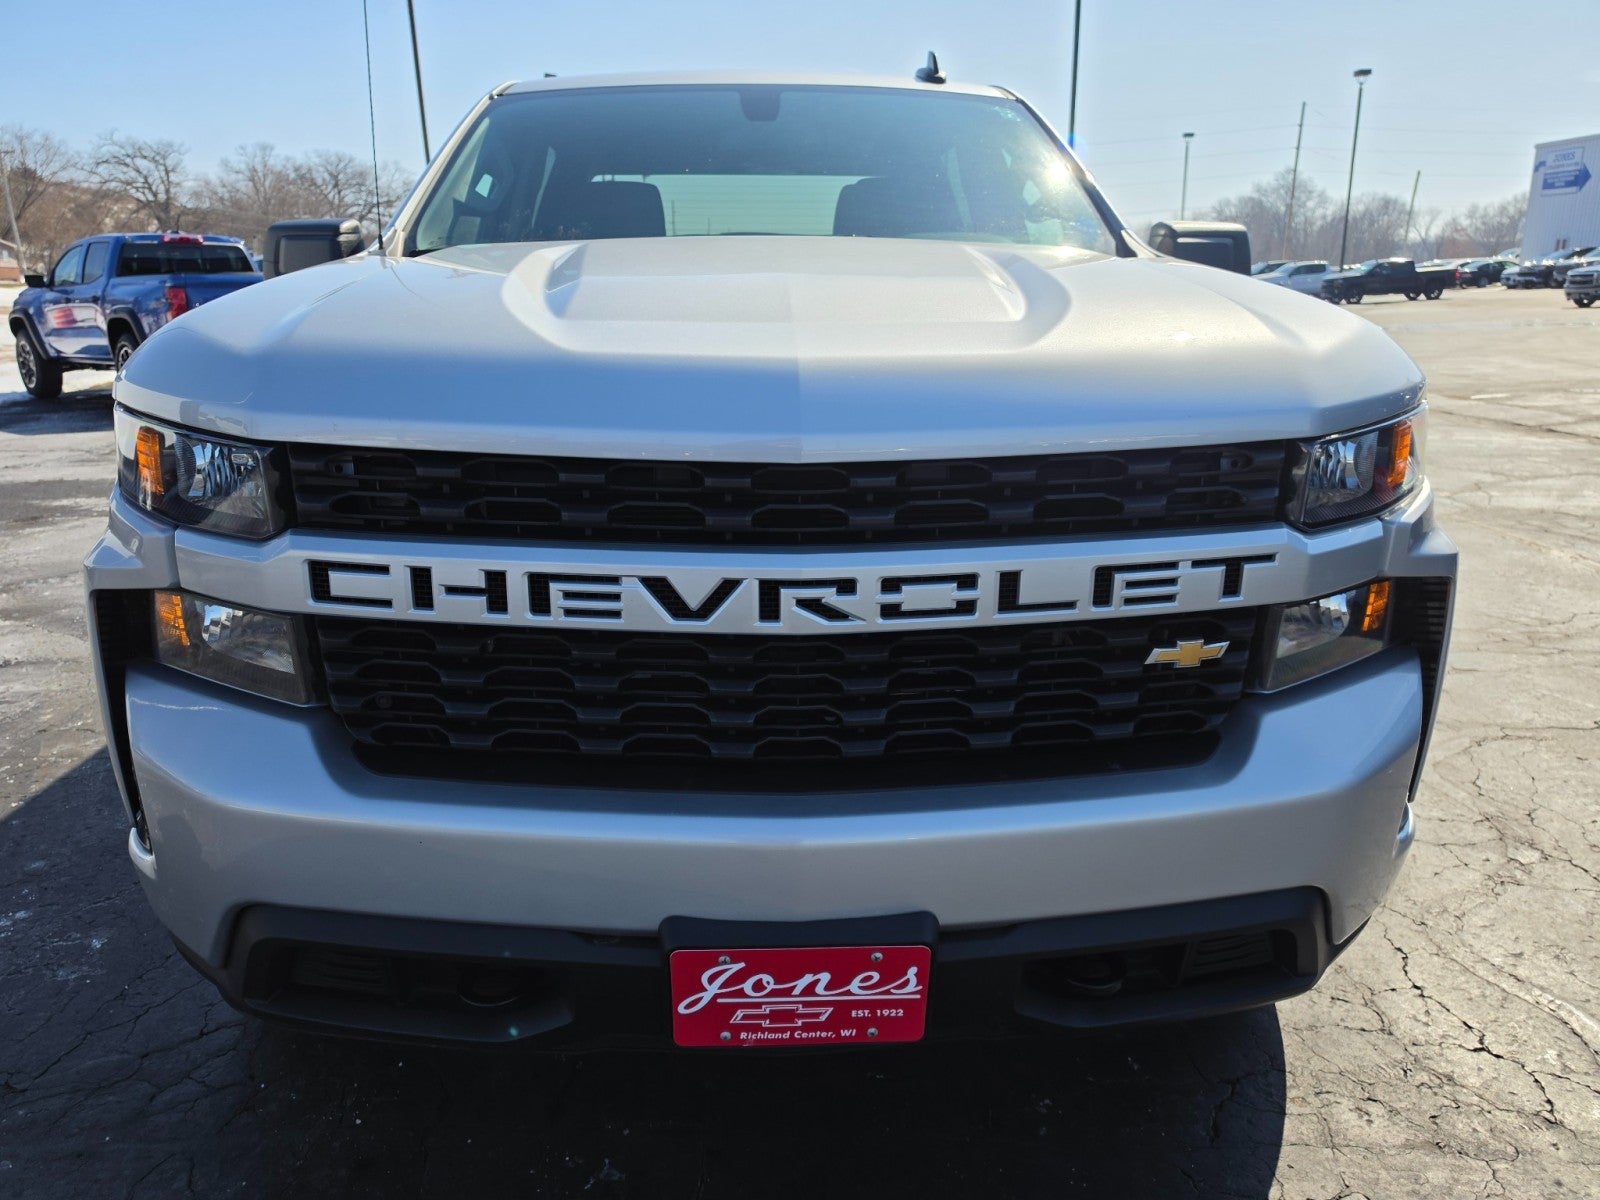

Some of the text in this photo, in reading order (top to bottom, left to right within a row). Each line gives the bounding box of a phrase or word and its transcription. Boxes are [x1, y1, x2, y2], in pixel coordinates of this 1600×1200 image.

[306, 551, 1278, 627] CHEVROLET
[677, 962, 923, 1015] Jones
[851, 1008, 905, 1018] EST. 1922
[740, 1028, 857, 1040] Richland Center, WI
